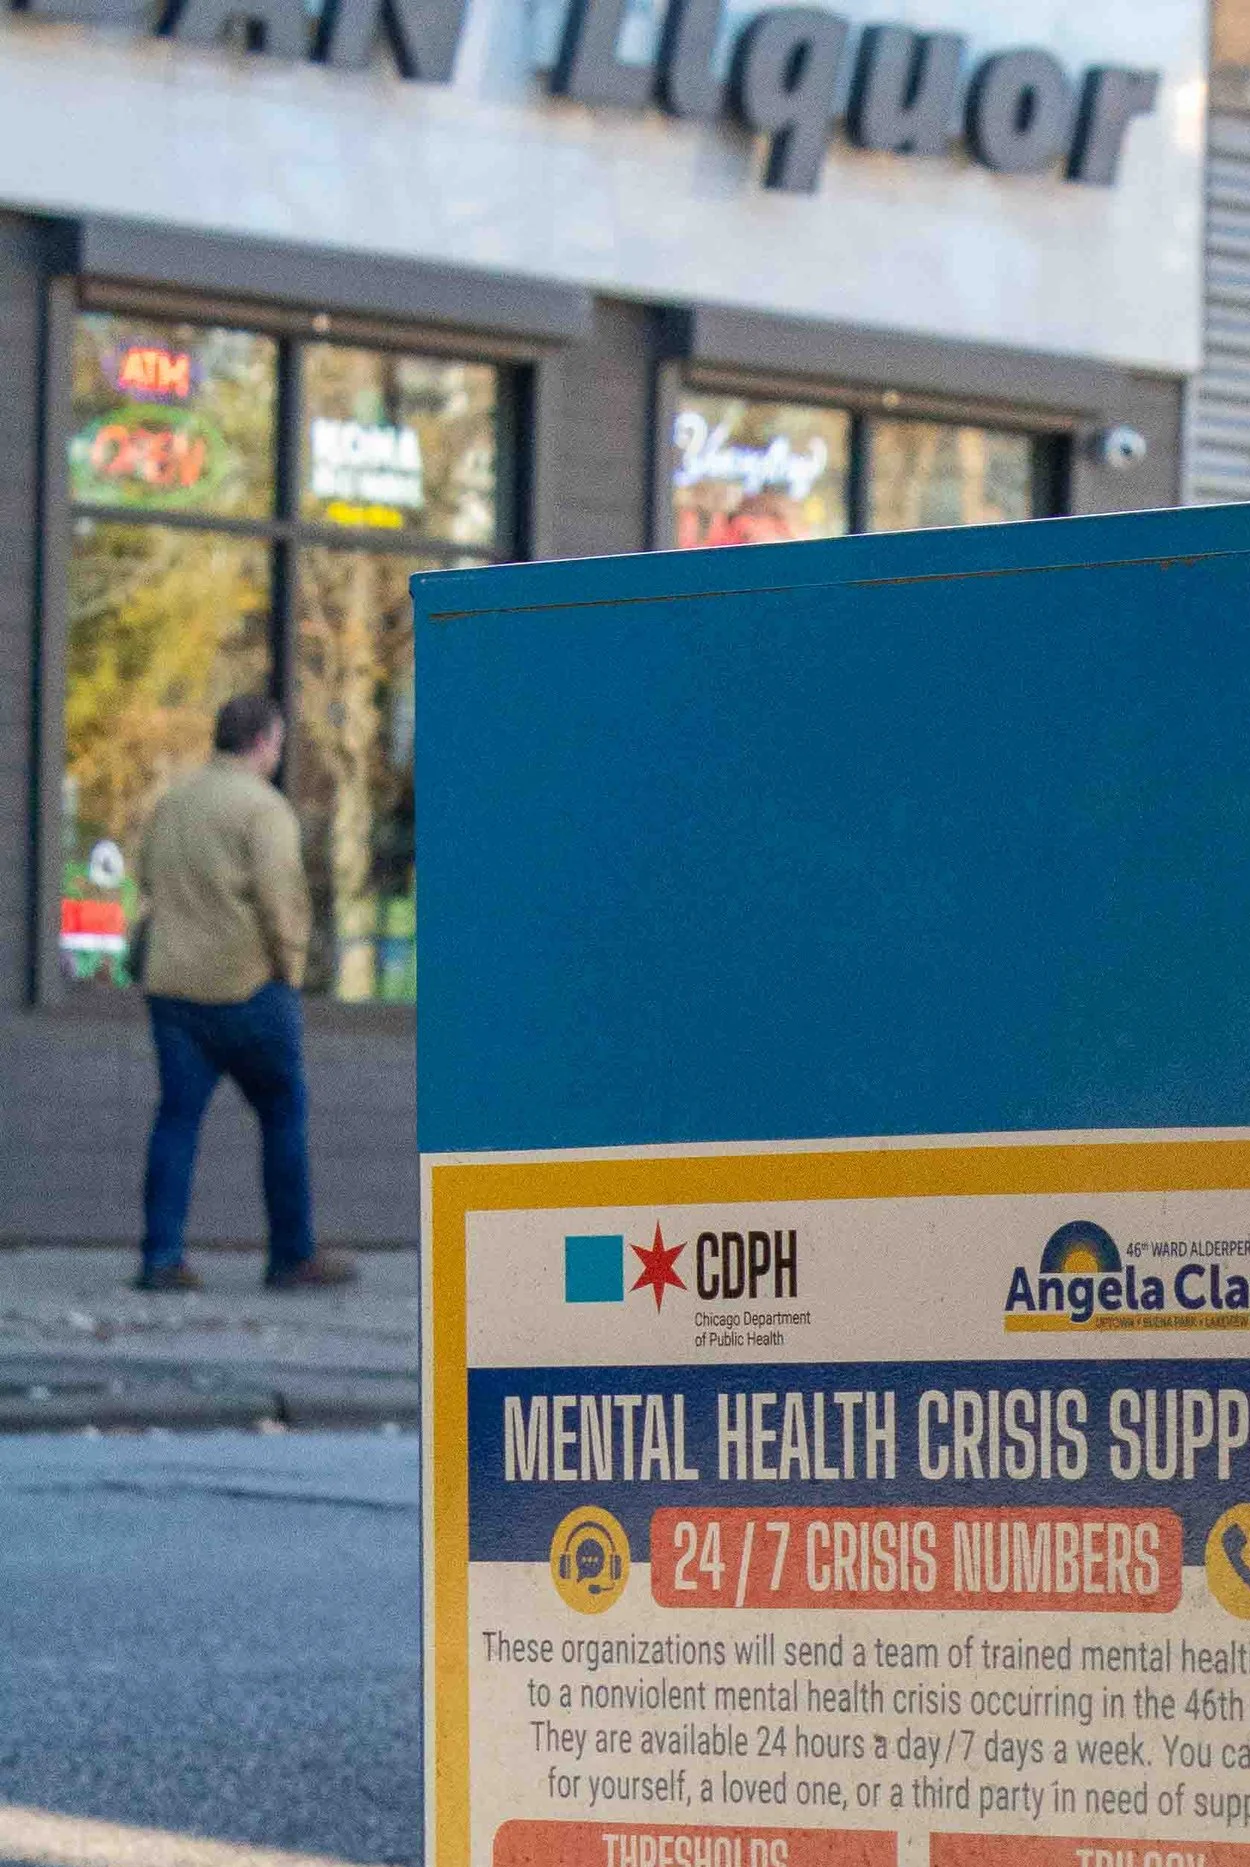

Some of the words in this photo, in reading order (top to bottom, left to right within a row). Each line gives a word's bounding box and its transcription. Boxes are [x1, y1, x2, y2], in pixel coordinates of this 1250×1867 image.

[547, 0, 1161, 194] Liquor
[119, 346, 190, 397] ATM
[696, 1230, 797, 1300] CDPH
[1126, 1241, 1149, 1257] 46th
[1152, 1242, 1187, 1256] WARD
[1005, 1264, 1164, 1323] Angela
[695, 1312, 740, 1329] Chicago
[744, 1311, 811, 1329] Department
[695, 1333, 706, 1347] of
[710, 1332, 744, 1346] Public
[748, 1332, 784, 1346] Health
[504, 1394, 699, 1481] MENTAL
[717, 1391, 895, 1480] HEALTH
[918, 1389, 1087, 1481] CRISIS
[807, 1520, 937, 1592] CRISIS
[954, 1521, 1159, 1595] NUMBERS
[483, 1631, 554, 1663] These
[562, 1633, 726, 1672] organizations
[735, 1634, 774, 1666] will
[785, 1636, 842, 1667] send
[853, 1643, 865, 1667] a
[875, 1638, 937, 1670] team
[948, 1635, 974, 1667] of
[984, 1638, 1072, 1671] trained
[1082, 1640, 1170, 1672] mental
[528, 1678, 551, 1707] to
[560, 1684, 572, 1708] a
[581, 1679, 706, 1711] nonviolent
[715, 1680, 798, 1713] mental
[808, 1681, 884, 1714] health
[893, 1683, 961, 1716] crisis
[972, 1687, 1092, 1725] occurring
[1104, 1688, 1125, 1718] in
[1136, 1690, 1175, 1721] the
[1185, 1690, 1244, 1722] 46th
[530, 1720, 586, 1759] They
[596, 1727, 632, 1754] are
[641, 1723, 748, 1757] available
[758, 1726, 787, 1757] 24
[797, 1727, 865, 1759] hours
[875, 1735, 887, 1758] a
[985, 1735, 1043, 1771] days
[1054, 1740, 1067, 1764] a
[1077, 1733, 1151, 1767] week.
[1163, 1735, 1211, 1769] You
[548, 1766, 580, 1798] for
[589, 1768, 691, 1807] yourself,
[701, 1778, 713, 1802] a
[723, 1772, 787, 1804] loved
[797, 1780, 848, 1810] one,
[857, 1781, 881, 1806] or
[891, 1783, 903, 1807] a
[912, 1776, 969, 1810] third
[980, 1786, 1044, 1820] party
[1054, 1782, 1076, 1813] in
[1087, 1782, 1147, 1815] need
[1158, 1784, 1185, 1816] of
